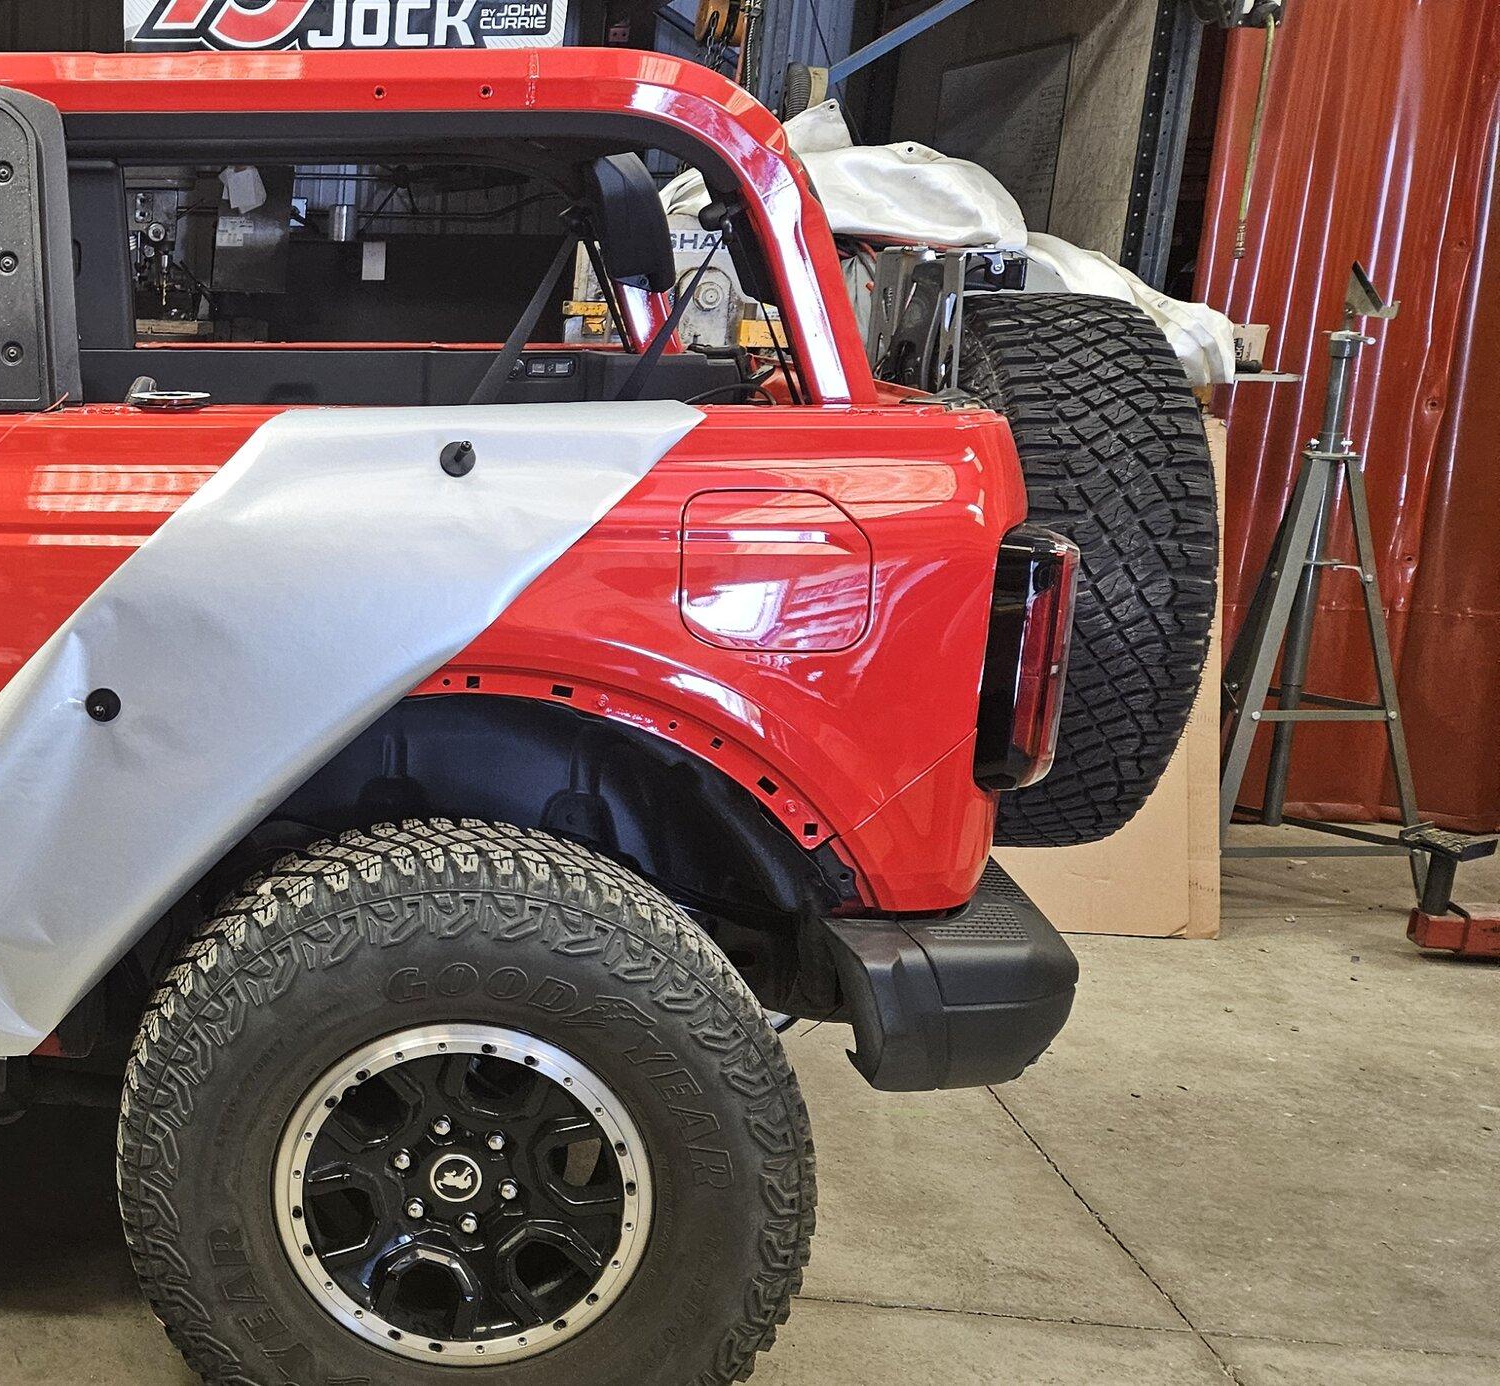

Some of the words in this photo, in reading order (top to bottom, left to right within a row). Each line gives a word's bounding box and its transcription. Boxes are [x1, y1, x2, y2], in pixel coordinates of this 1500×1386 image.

[481, 8, 496, 17] BY
[496, 3, 547, 17] JOHN
[307, 0, 475, 48] JOCK
[480, 16, 546, 29] CURRIE
